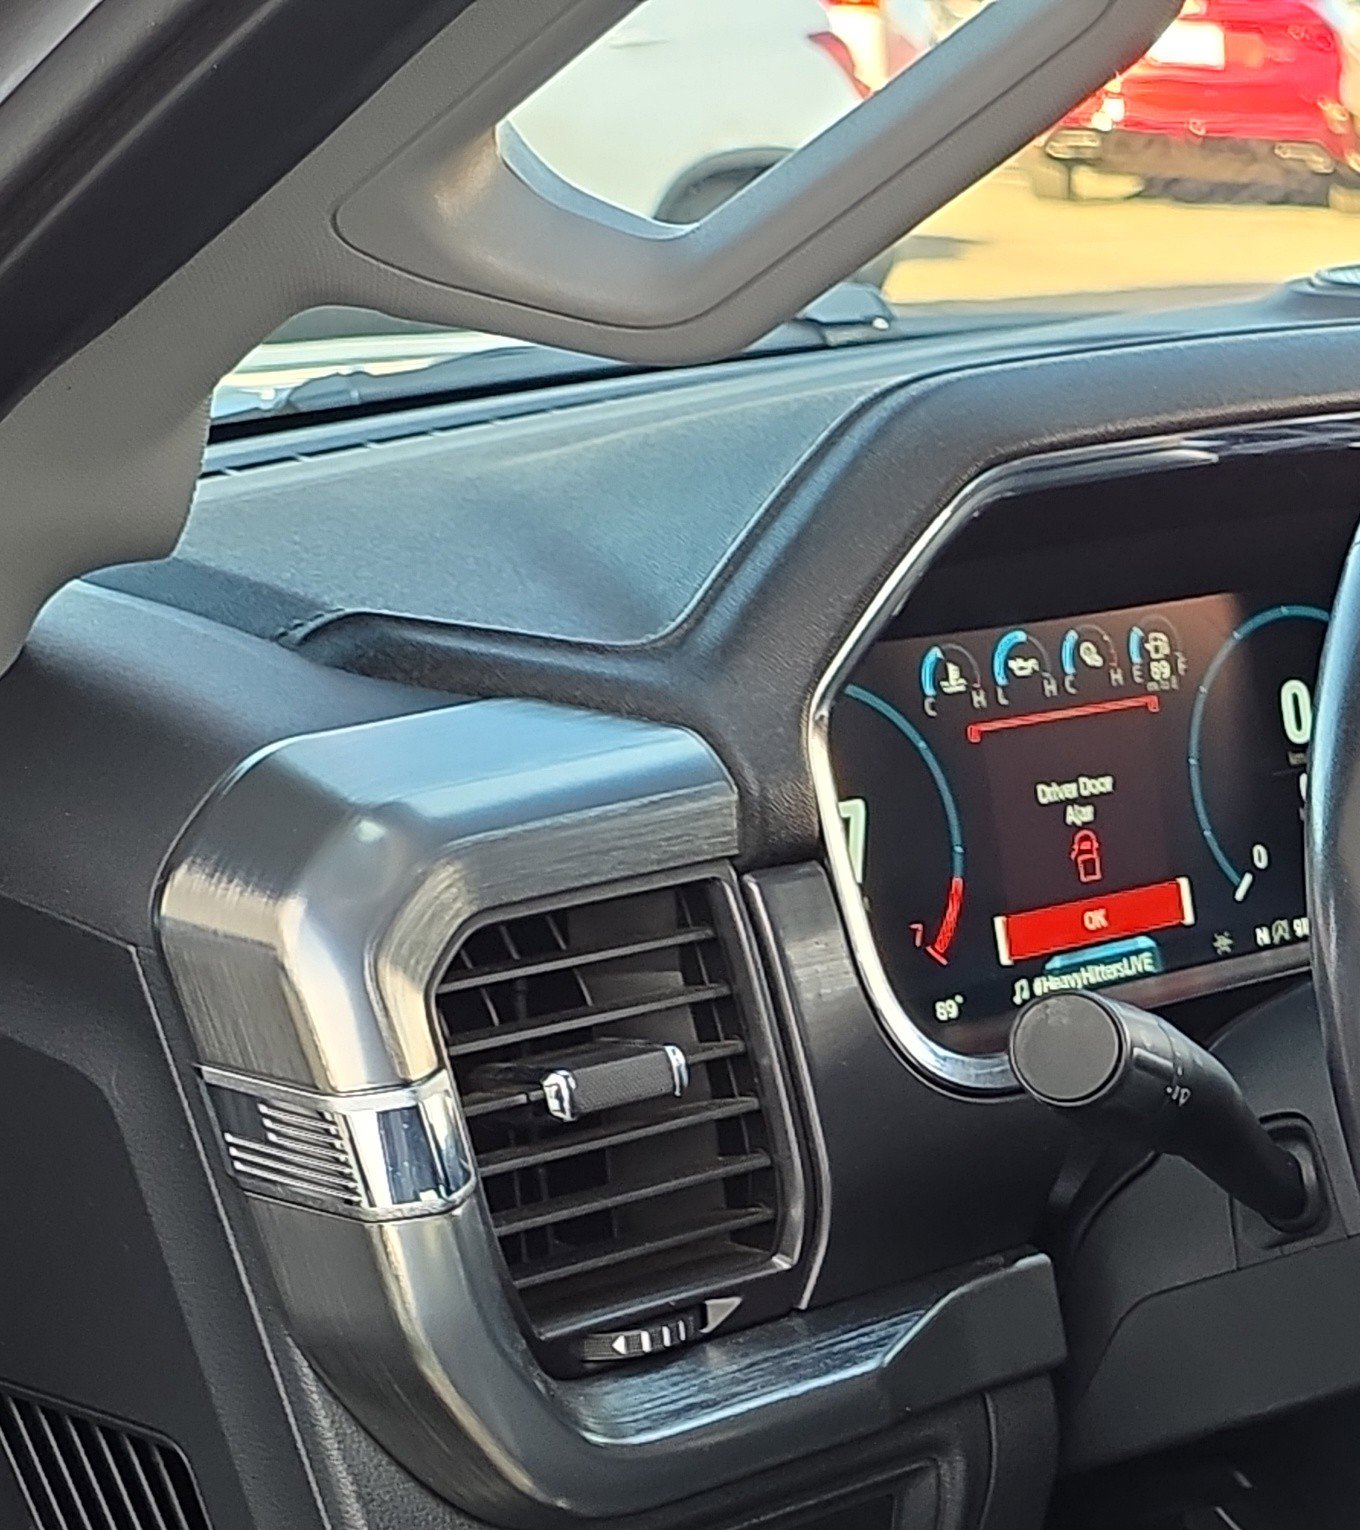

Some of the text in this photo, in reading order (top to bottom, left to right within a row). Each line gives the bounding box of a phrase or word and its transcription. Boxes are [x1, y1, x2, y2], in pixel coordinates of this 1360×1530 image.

[1064, 676, 1077, 694] C
[1109, 668, 1125, 687] H
[1132, 665, 1144, 684] E
[1042, 675, 1058, 697] H
[924, 697, 937, 717] C
[971, 690, 987, 708] H
[1280, 679, 1313, 744] 0
[1036, 775, 1114, 804] Driver Door
[1252, 844, 1269, 870] 0
[1083, 908, 1108, 931] OK
[909, 922, 924, 948] 7
[1255, 926, 1271, 947] N
